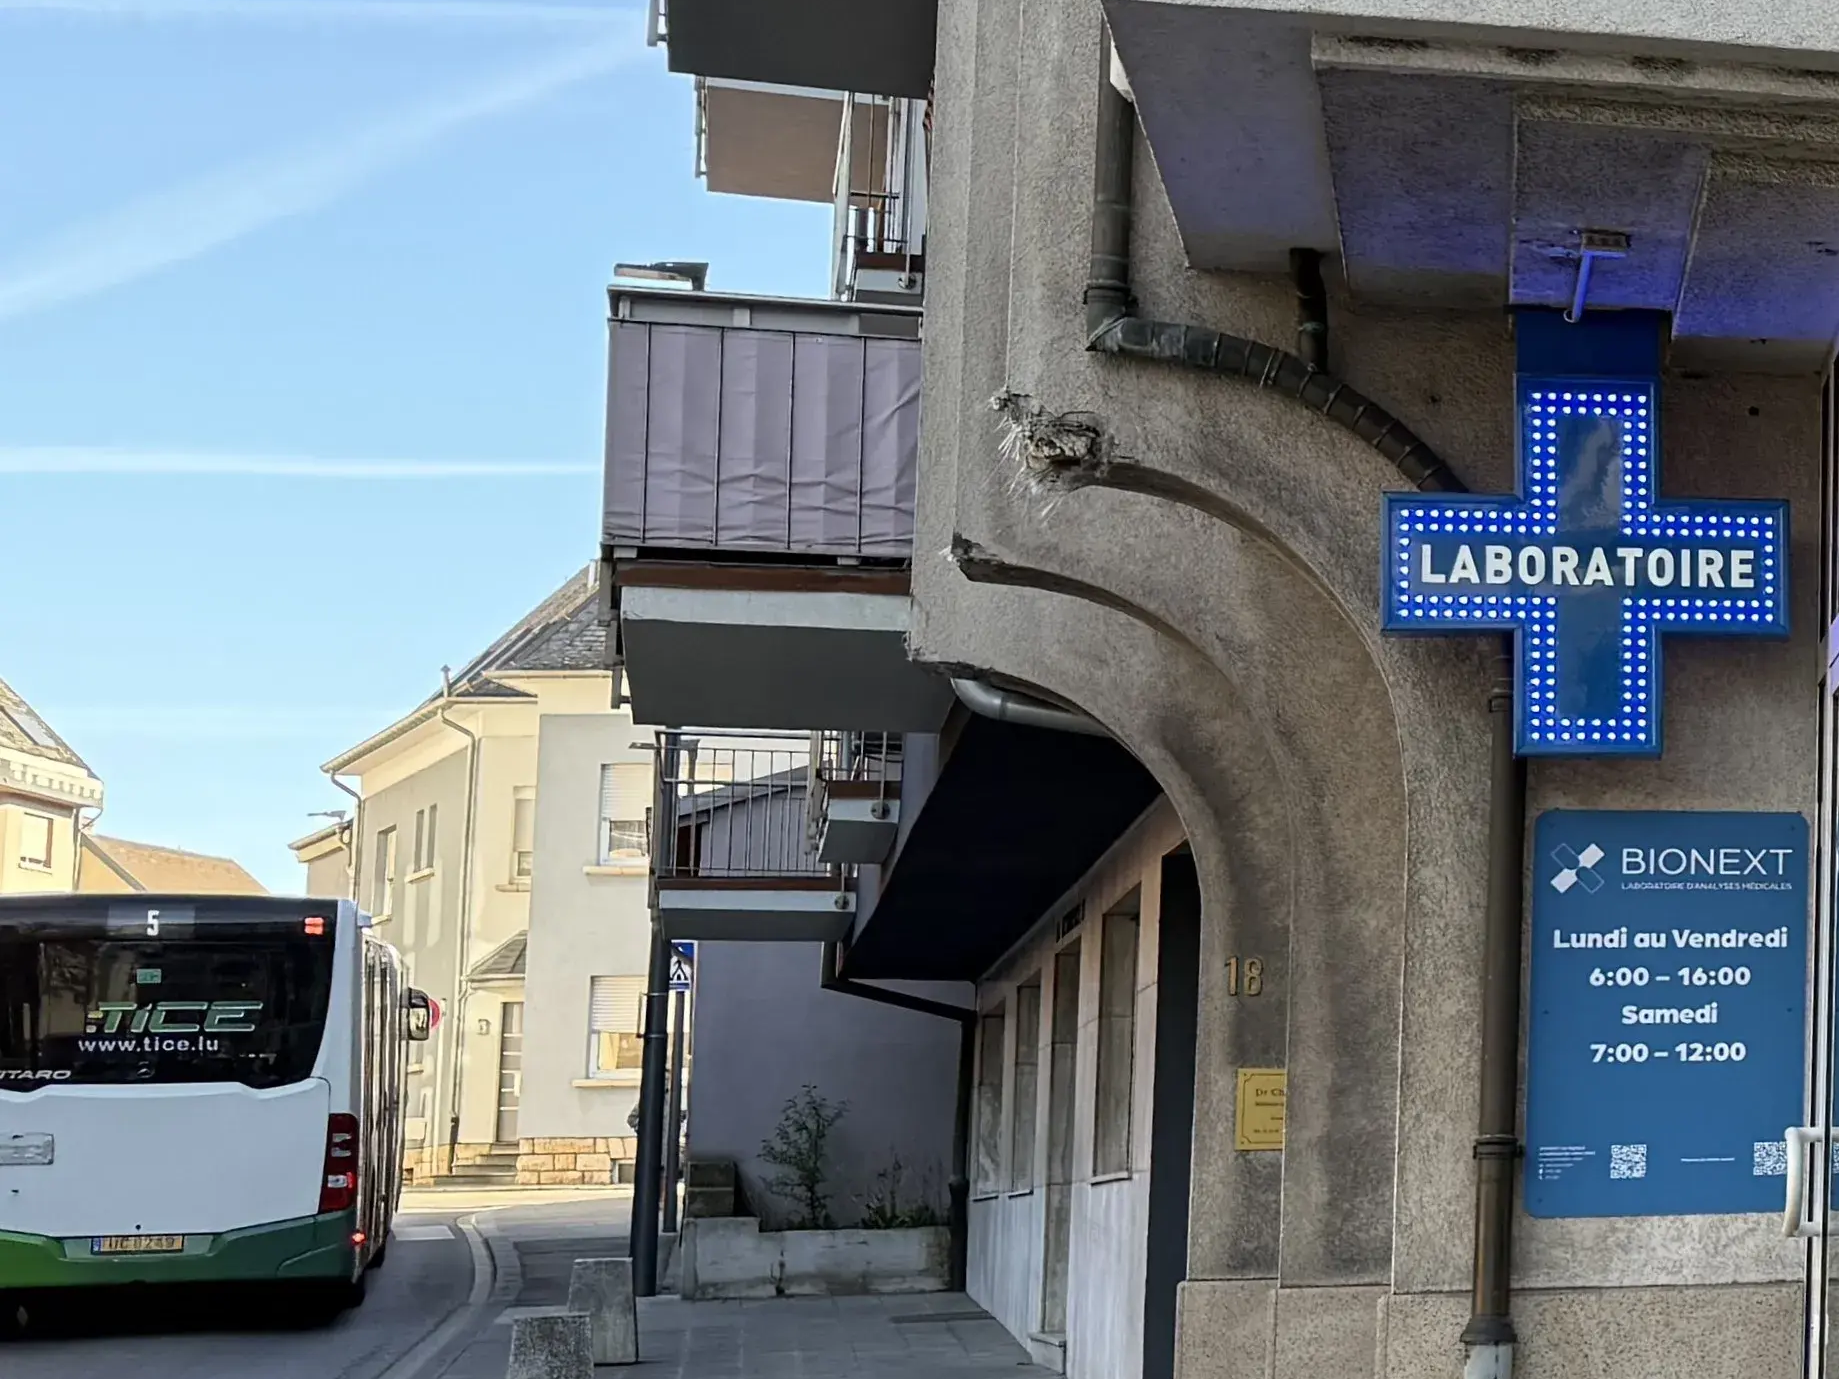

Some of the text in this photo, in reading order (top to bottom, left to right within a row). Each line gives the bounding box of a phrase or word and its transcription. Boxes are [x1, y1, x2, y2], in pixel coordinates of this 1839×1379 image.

[1420, 543, 1756, 589] LABORATOIRE
[1621, 848, 1793, 876] BIONEXT
[146, 909, 160, 936] 5
[1553, 926, 1788, 949] Lundi au Vendredi
[1224, 955, 1264, 997] 18
[1589, 966, 1650, 987] 6:00
[1677, 966, 1751, 987] 16:00
[1621, 1001, 1718, 1025] Samedi
[78, 1036, 219, 1053] www.tice.lu
[1590, 1043, 1649, 1063] 7:00
[1674, 1042, 1747, 1063] 12:00
